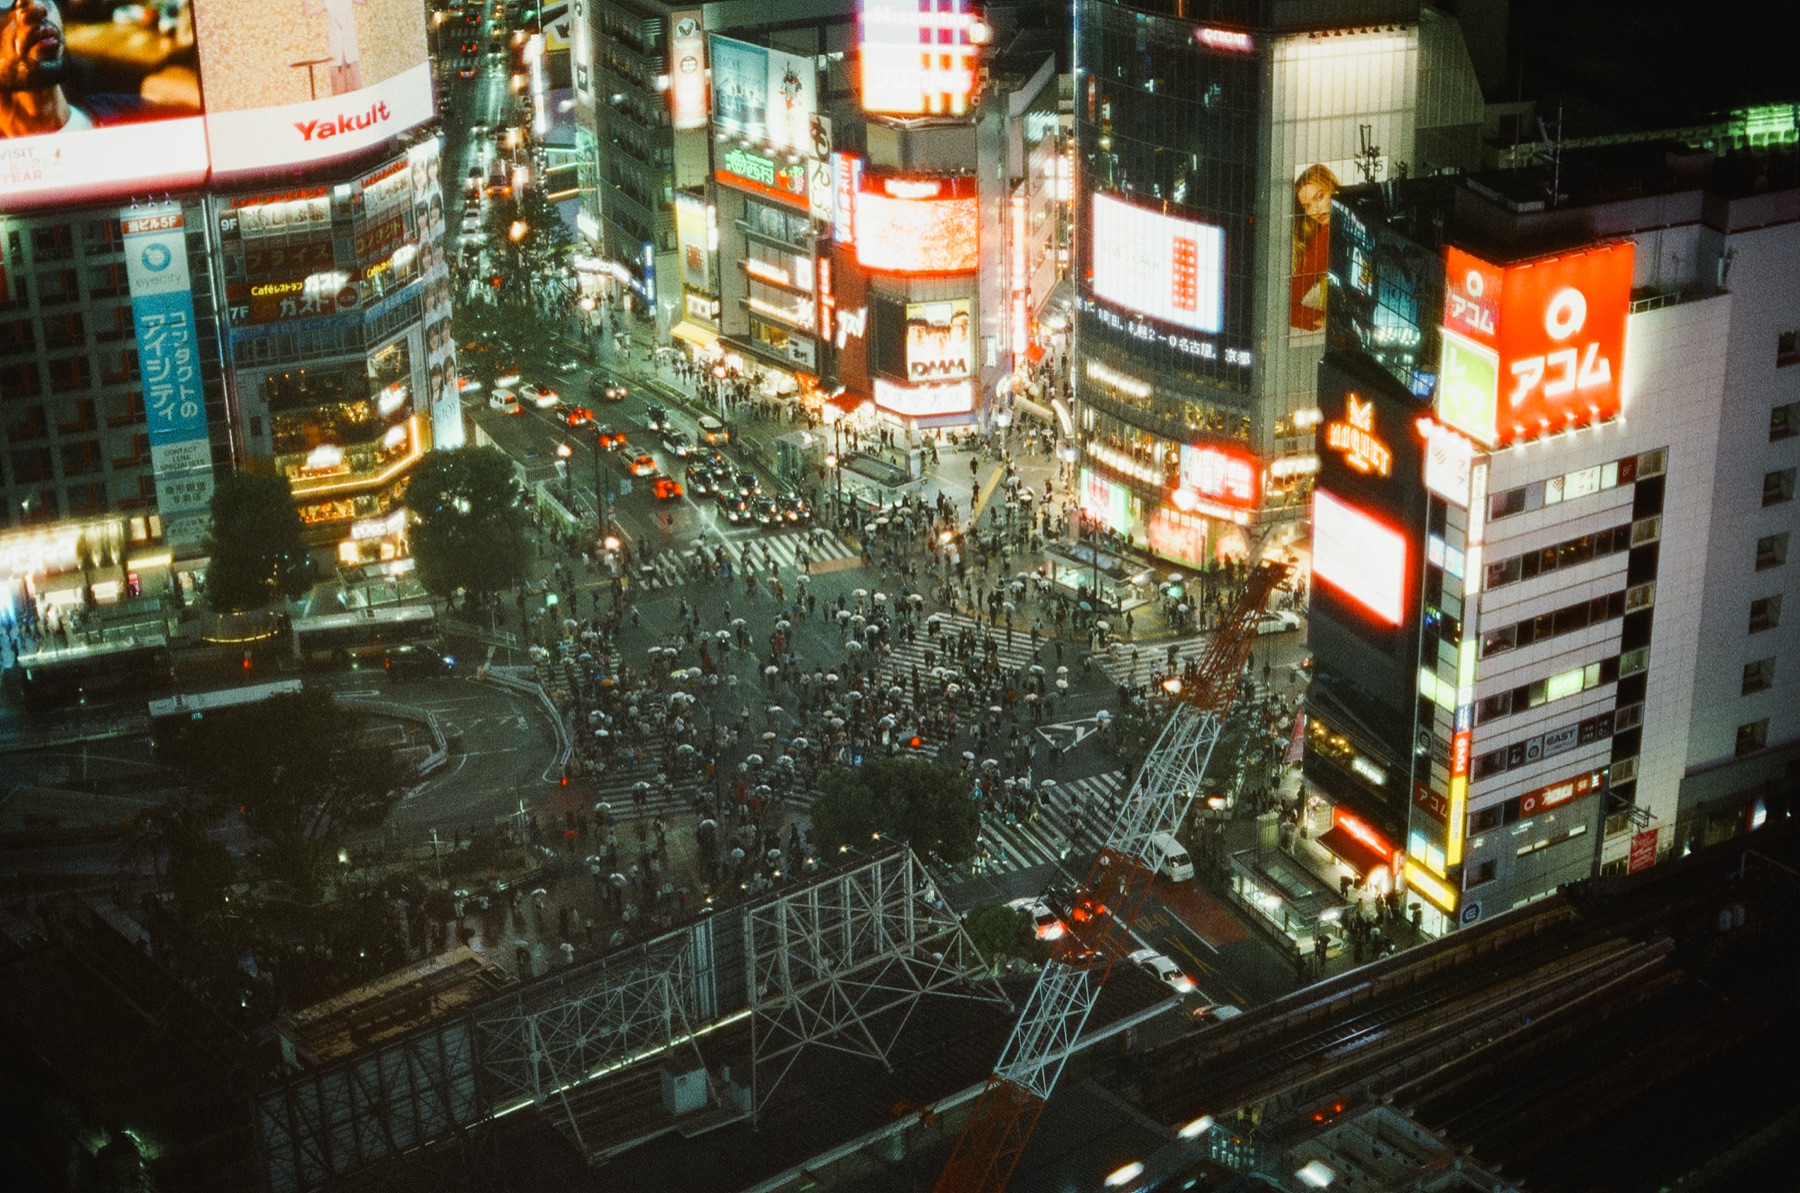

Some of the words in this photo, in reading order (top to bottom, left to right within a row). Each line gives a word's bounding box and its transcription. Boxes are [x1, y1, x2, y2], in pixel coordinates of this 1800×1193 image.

[294, 101, 391, 143] Yakult
[2, 169, 43, 184] YEAR
[219, 219, 238, 231] 9F
[230, 306, 249, 320] 7F
[279, 296, 329, 318] ガスト
[1452, 294, 1494, 335] アコム
[140, 314, 176, 421] アイシティ
[169, 311, 198, 418] コンタクトの
[911, 357, 967, 377] DMM
[1224, 349, 1252, 366] 京都
[1511, 342, 1612, 407] アコム
[164, 446, 197, 457] CONTACT
[172, 454, 191, 463] LENS
[1546, 729, 1576, 746] EAST
[1419, 788, 1447, 818] アコム
